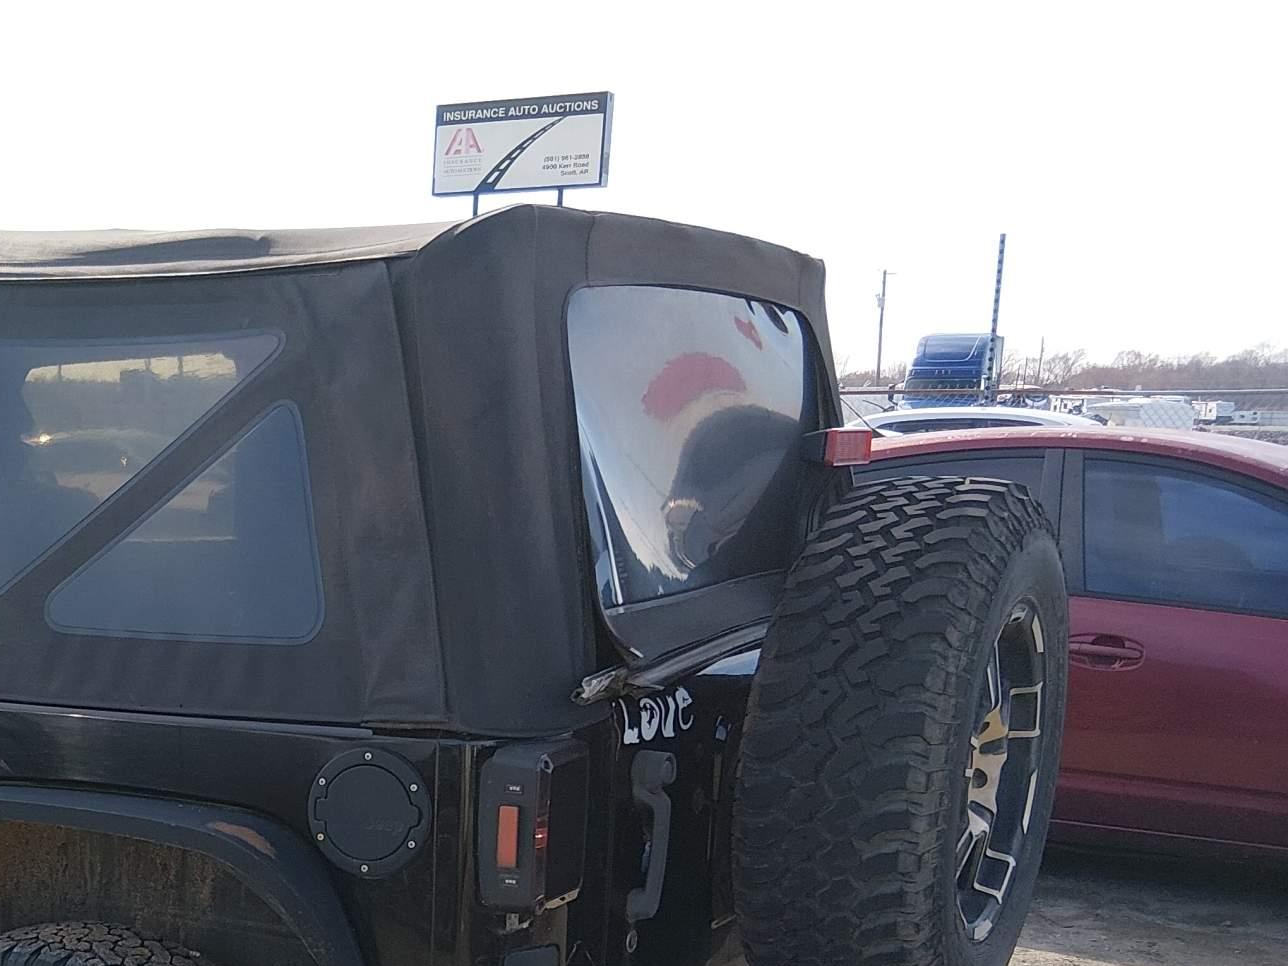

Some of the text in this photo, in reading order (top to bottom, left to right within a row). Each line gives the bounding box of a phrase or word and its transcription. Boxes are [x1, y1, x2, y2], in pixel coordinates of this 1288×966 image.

[443, 99, 599, 122] INSURANCE AUTO AUCTIONS
